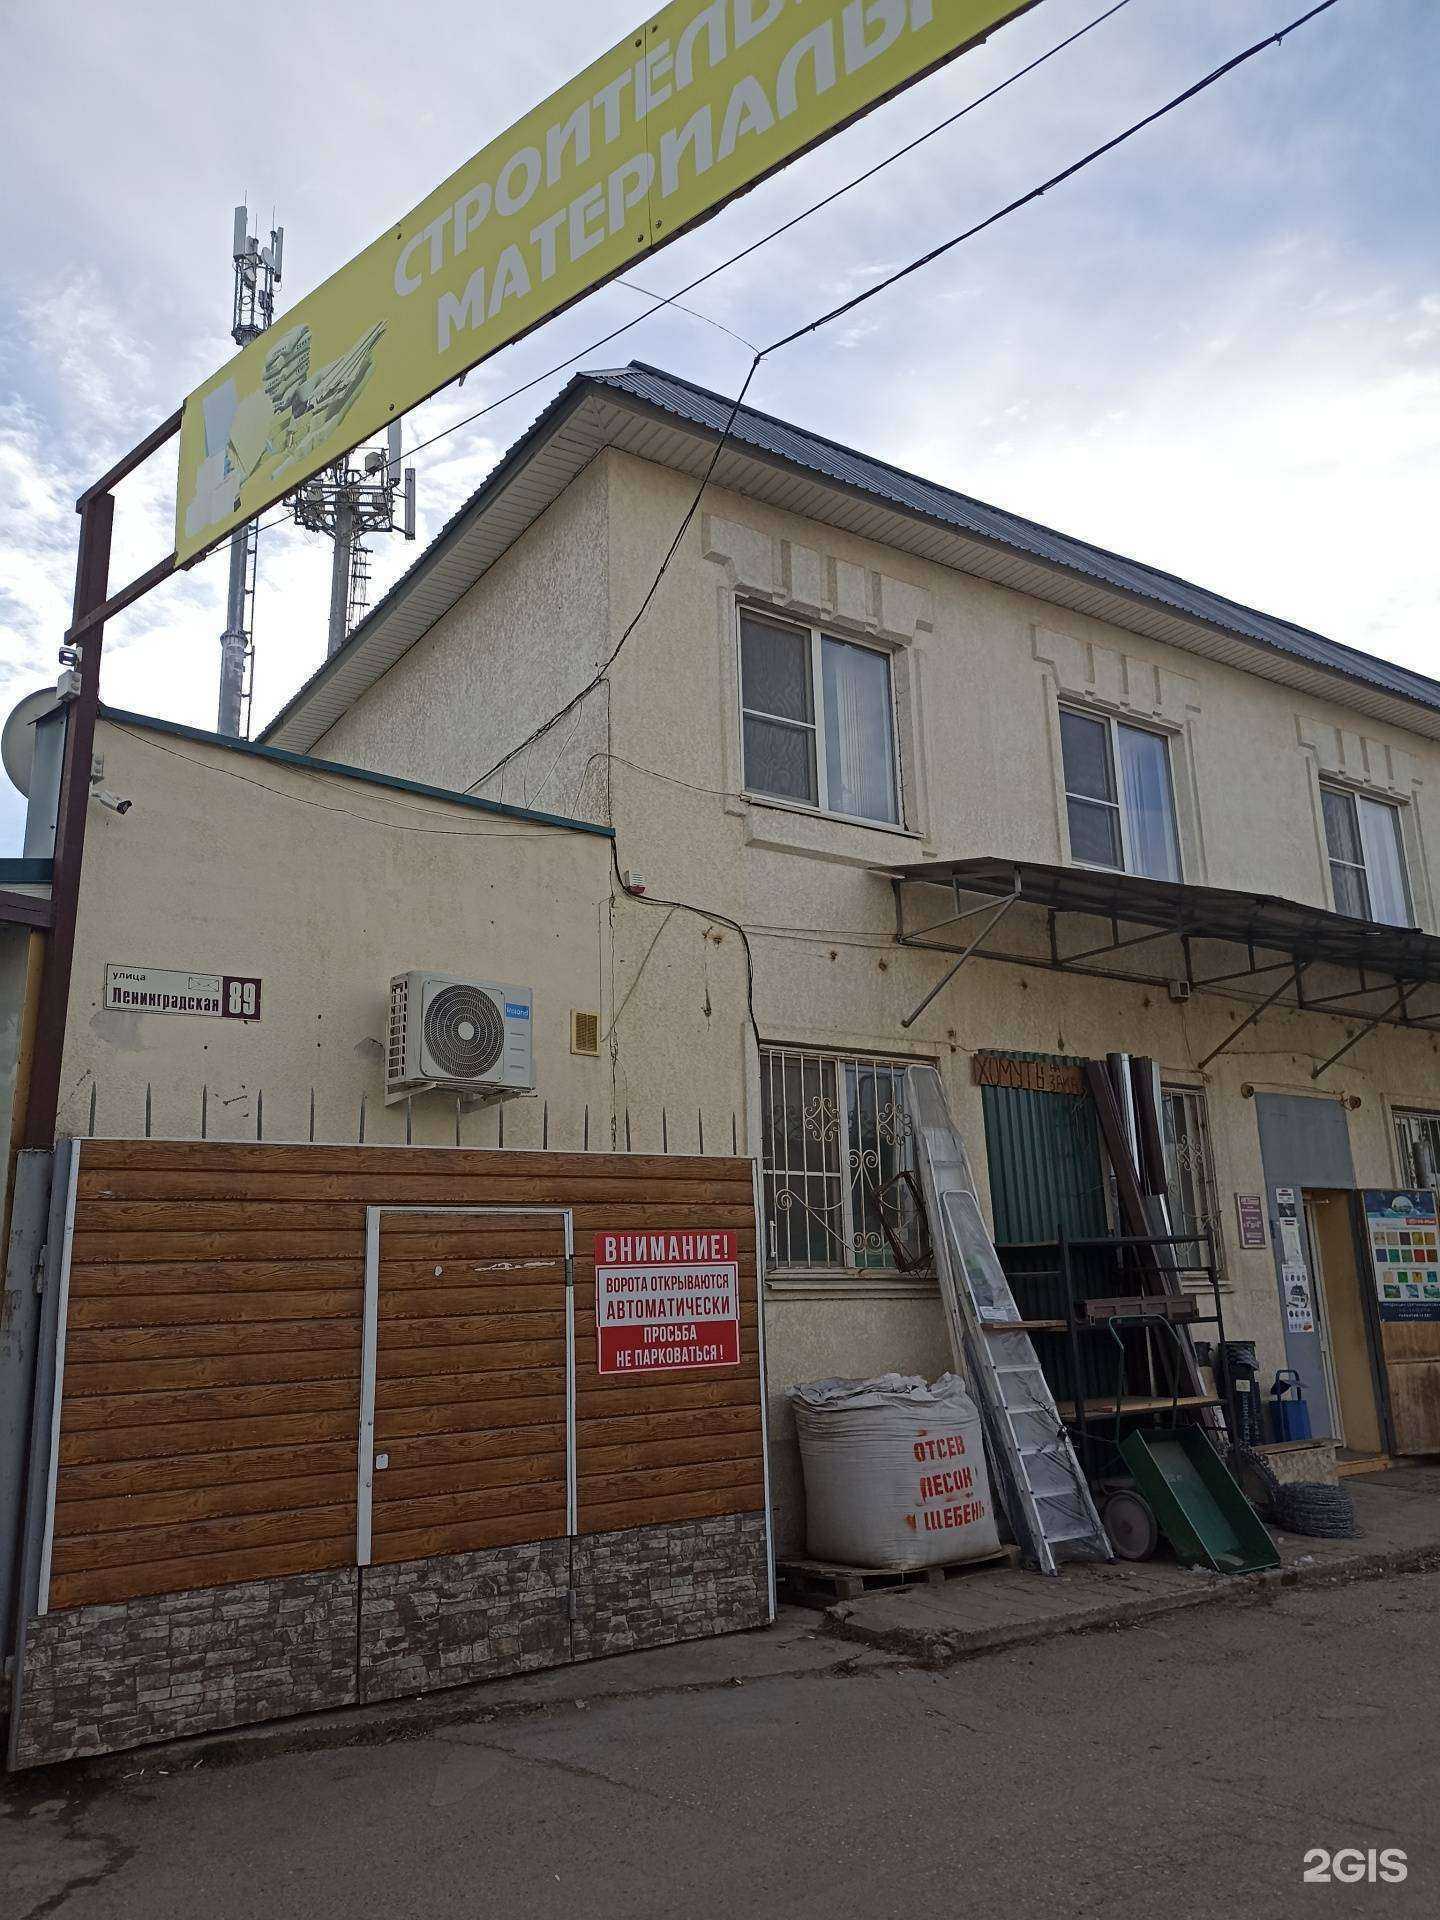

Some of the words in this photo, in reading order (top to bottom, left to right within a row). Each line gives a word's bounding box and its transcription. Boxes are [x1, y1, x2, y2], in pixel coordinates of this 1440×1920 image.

[394, 0, 801, 297] СТРОИТЕЛЬ
[437, 0, 934, 354] МАТЕРИАЛЫ
[112, 970, 146, 981] улица
[111, 986, 219, 1012] Ленинградская
[228, 981, 256, 1015] 89
[605, 1234, 728, 1262] ВНИМАНИЕ!
[606, 1276, 648, 1293] ВОРОТА
[650, 1273, 729, 1292] ОТКРЫВАЮТСЯ
[606, 1295, 730, 1320] АВТОМАТИЧЕСКИ
[643, 1324, 697, 1343] ПРОСЬБА
[616, 1350, 632, 1368] НЕ
[913, 1435, 966, 1463] ОТСЕВ
[919, 1466, 974, 1501] ПЕСОК
